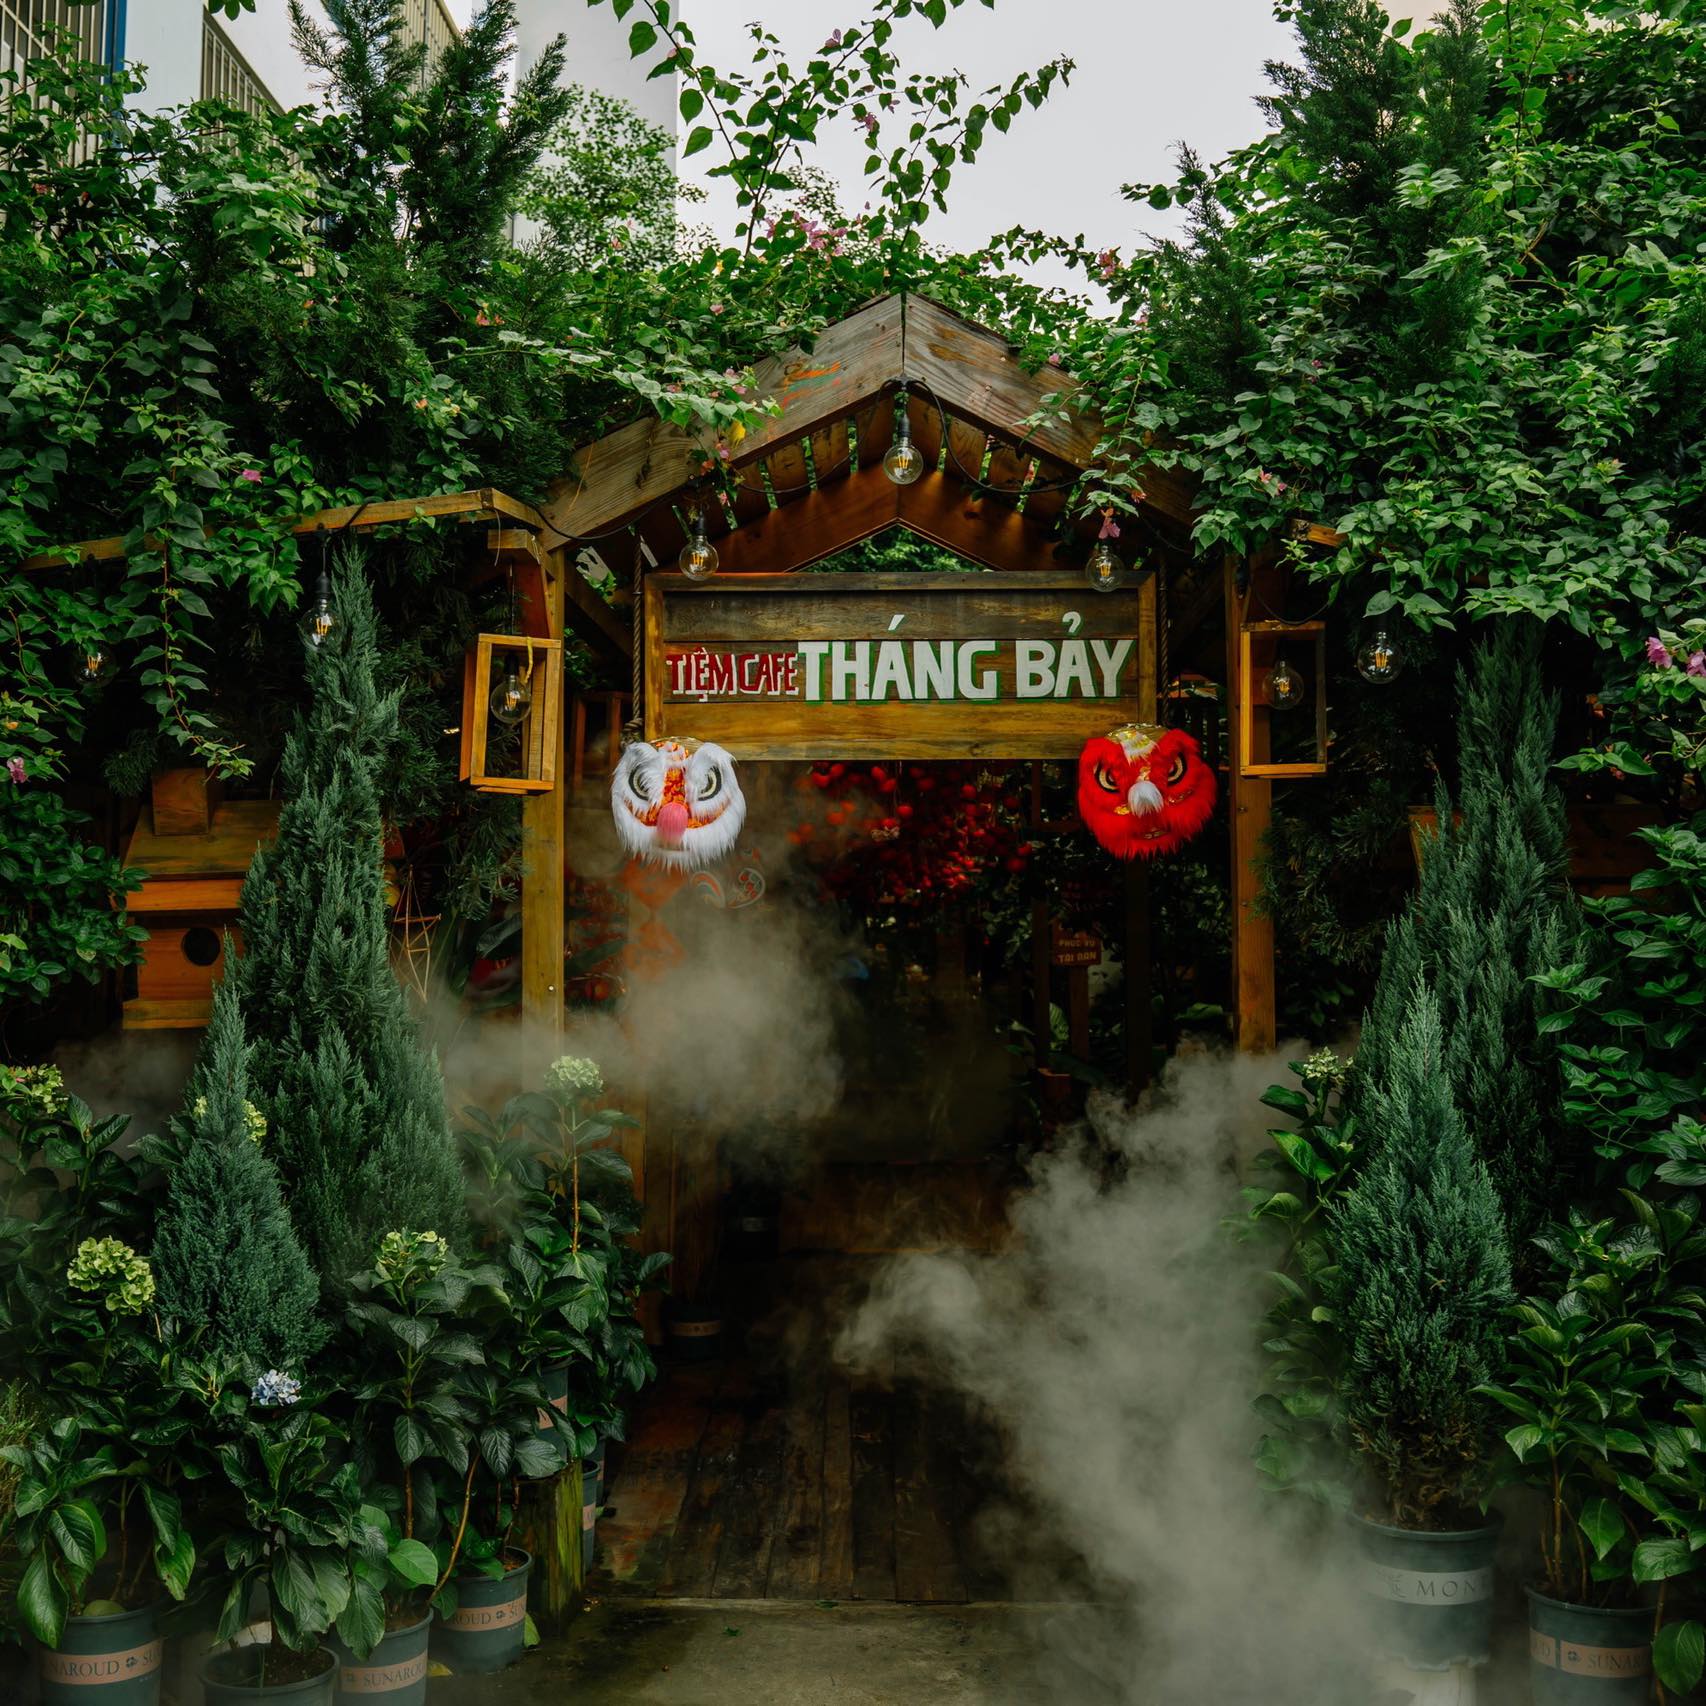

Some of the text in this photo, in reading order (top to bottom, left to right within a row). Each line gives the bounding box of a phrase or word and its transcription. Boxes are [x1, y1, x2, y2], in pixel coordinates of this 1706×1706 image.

[665, 611, 1134, 702] TIỆM CAFE THÁNG BẢY
